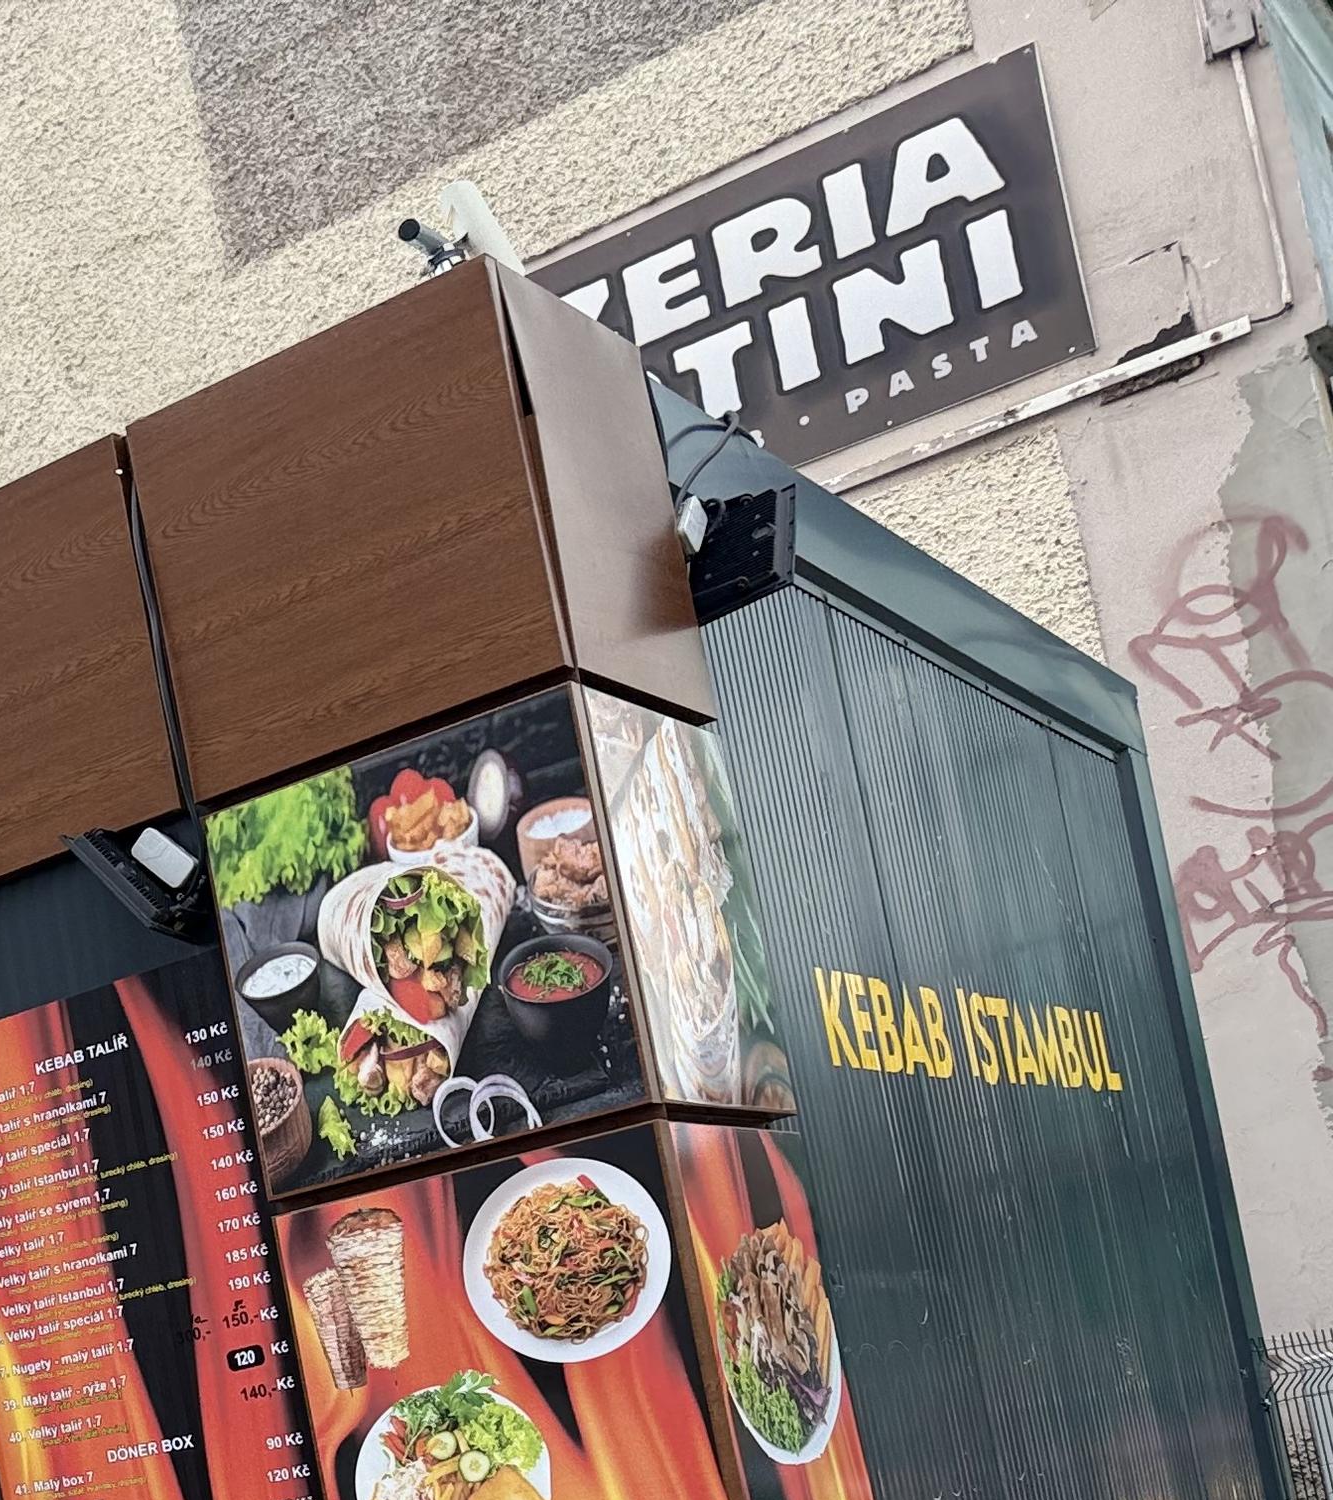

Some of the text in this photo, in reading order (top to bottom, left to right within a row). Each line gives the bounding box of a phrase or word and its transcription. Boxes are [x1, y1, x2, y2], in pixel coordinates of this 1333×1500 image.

[560, 117, 1006, 347] ERIA
[646, 209, 1023, 420] TINI
[844, 319, 1039, 414] PASTA
[184, 1020, 228, 1044] 130 Kč
[814, 966, 1123, 1092] KEBAB ISTAMBUL
[34, 1032, 128, 1075] KEBAB TALÍŘ
[189, 1047, 233, 1071] 140 Kč
[97, 1090, 107, 1104] 7
[196, 1084, 239, 1107] 150 Kč
[202, 1117, 245, 1139] 150 Kč
[210, 1148, 254, 1170] 140 Kč
[214, 1180, 258, 1202] 160 Kč
[217, 1211, 261, 1233] 170 Kč
[224, 1242, 269, 1263] 185 Kč
[227, 1270, 271, 1291] 190 Kč
[259, 1305, 279, 1321] Kč
[233, 1339, 289, 1366] 120 Kč
[275, 1375, 295, 1391] Kč
[106, 1433, 194, 1462] DÖNER BOX
[265, 1431, 304, 1450] 90 Kč
[266, 1463, 311, 1482] 120 Kč
